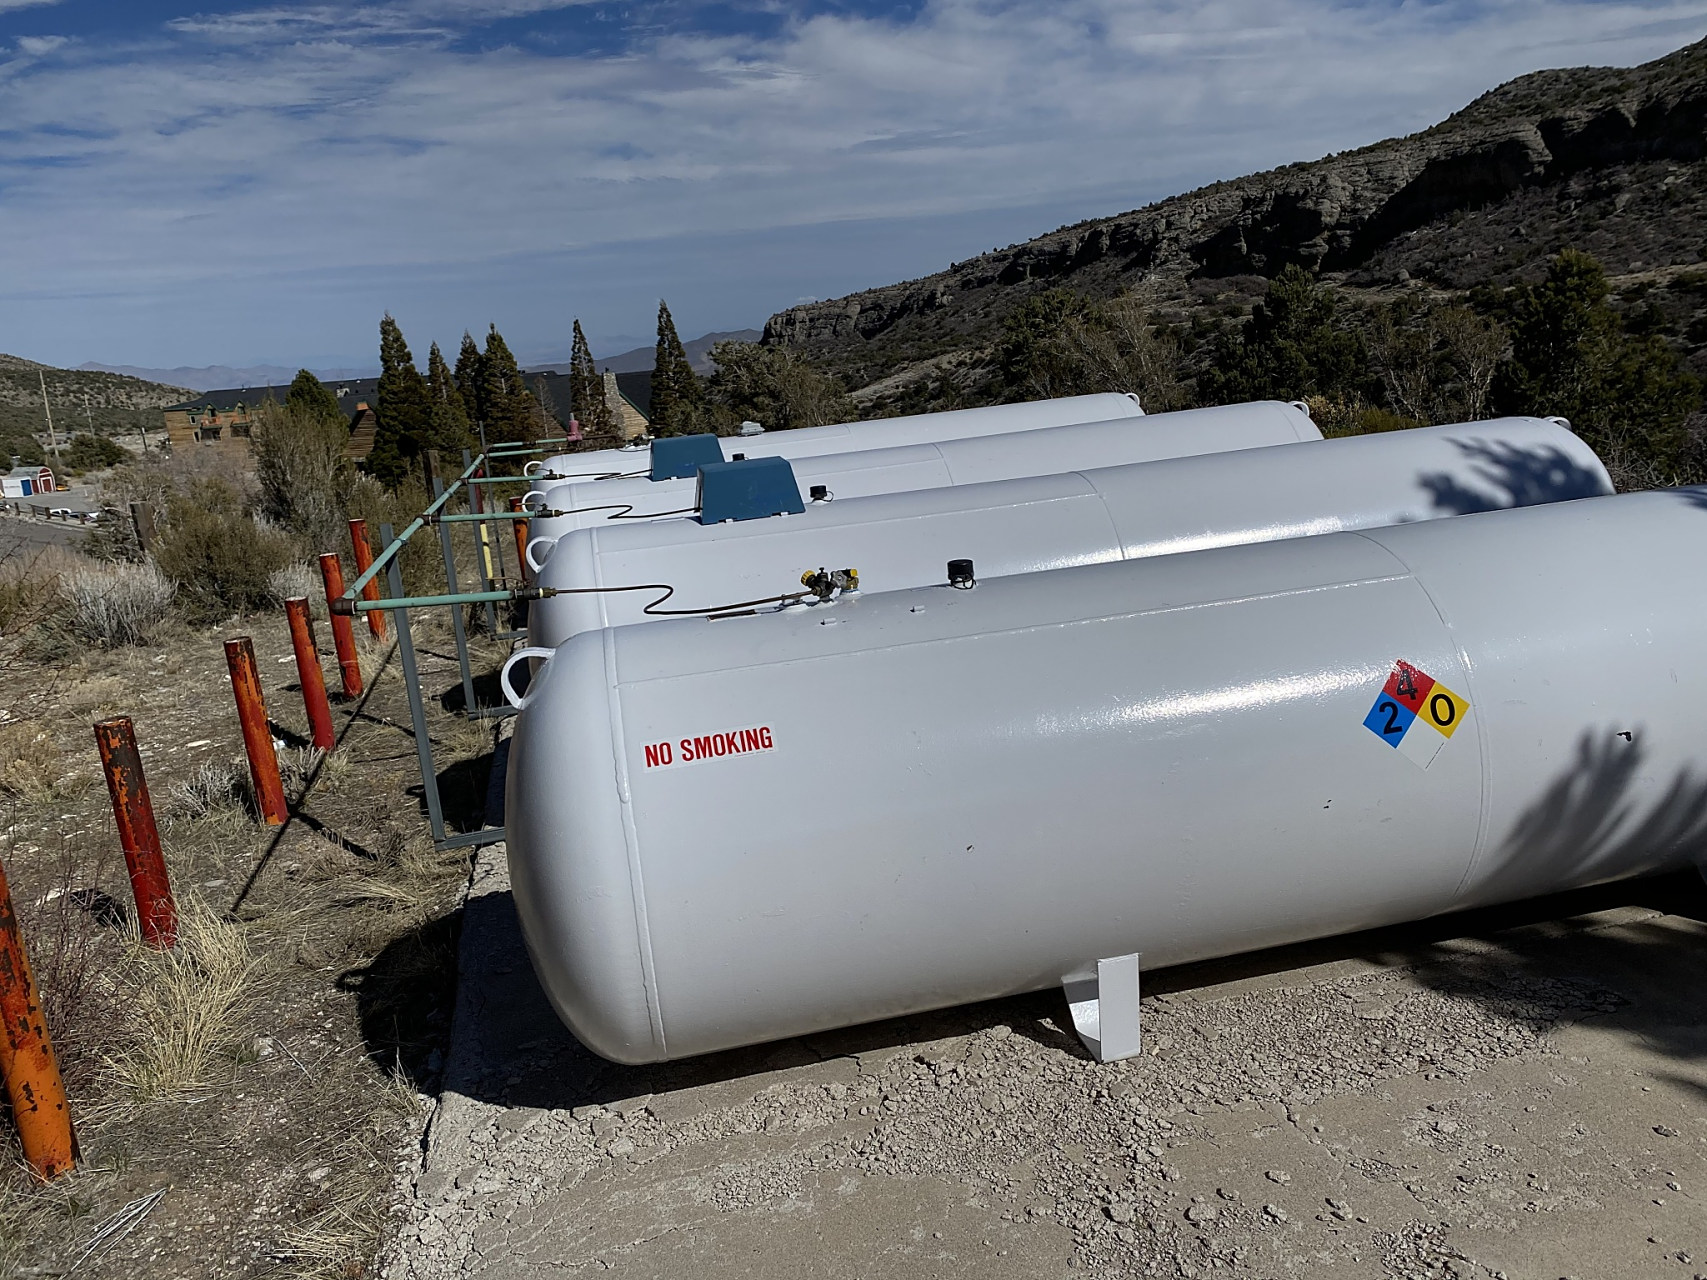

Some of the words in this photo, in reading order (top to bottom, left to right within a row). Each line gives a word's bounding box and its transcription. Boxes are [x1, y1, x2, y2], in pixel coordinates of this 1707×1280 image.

[1396, 669, 1418, 700] 4
[1379, 701, 1403, 735] 2
[1429, 693, 1456, 727] 0
[644, 742, 673, 768] NO
[680, 726, 773, 762] SMOKING
